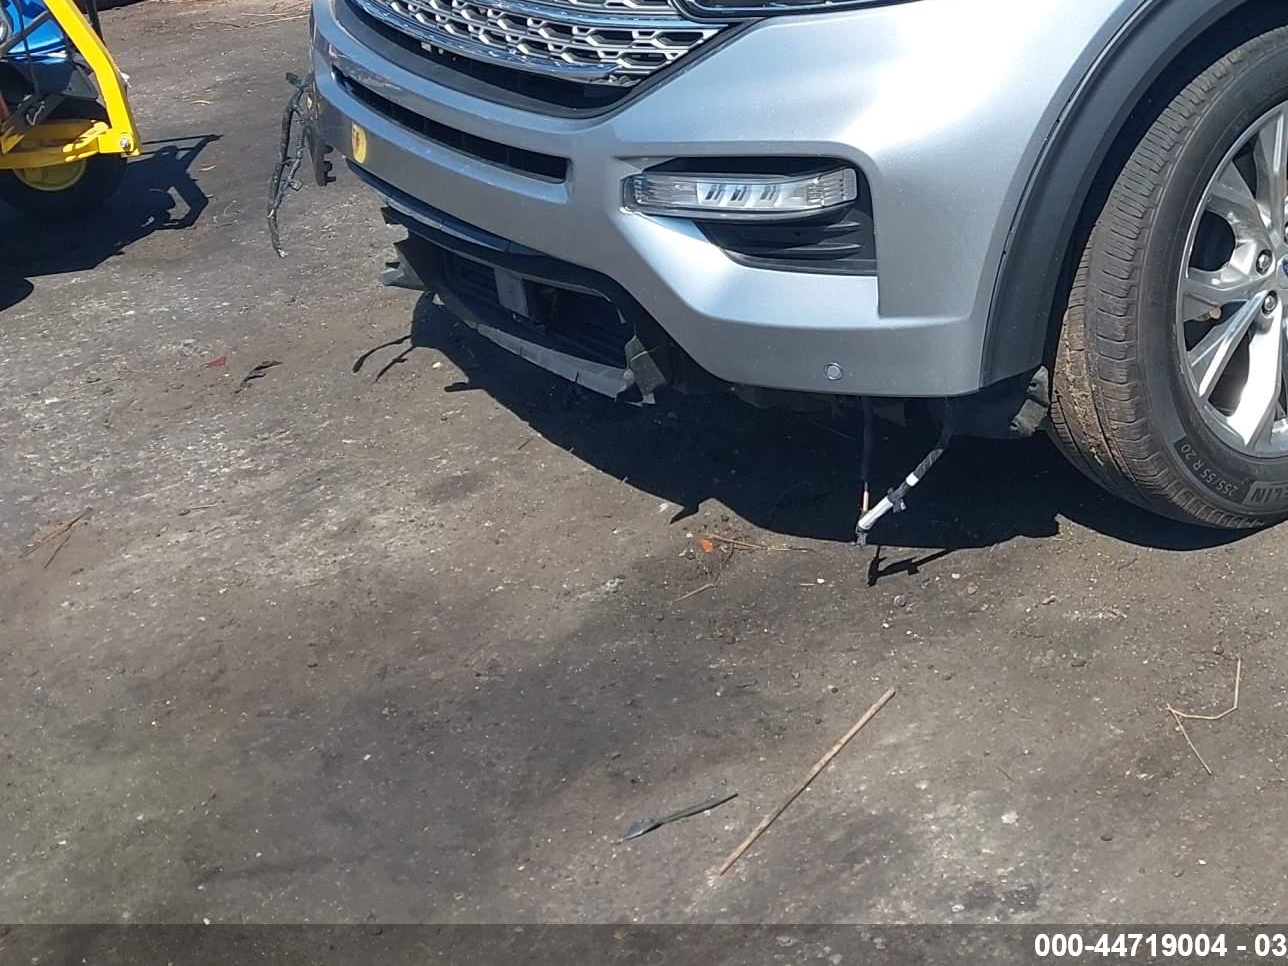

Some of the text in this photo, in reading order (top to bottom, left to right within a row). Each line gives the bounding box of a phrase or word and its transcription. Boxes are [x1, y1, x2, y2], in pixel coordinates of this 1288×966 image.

[1181, 443, 1239, 497] 255/55 R 20
